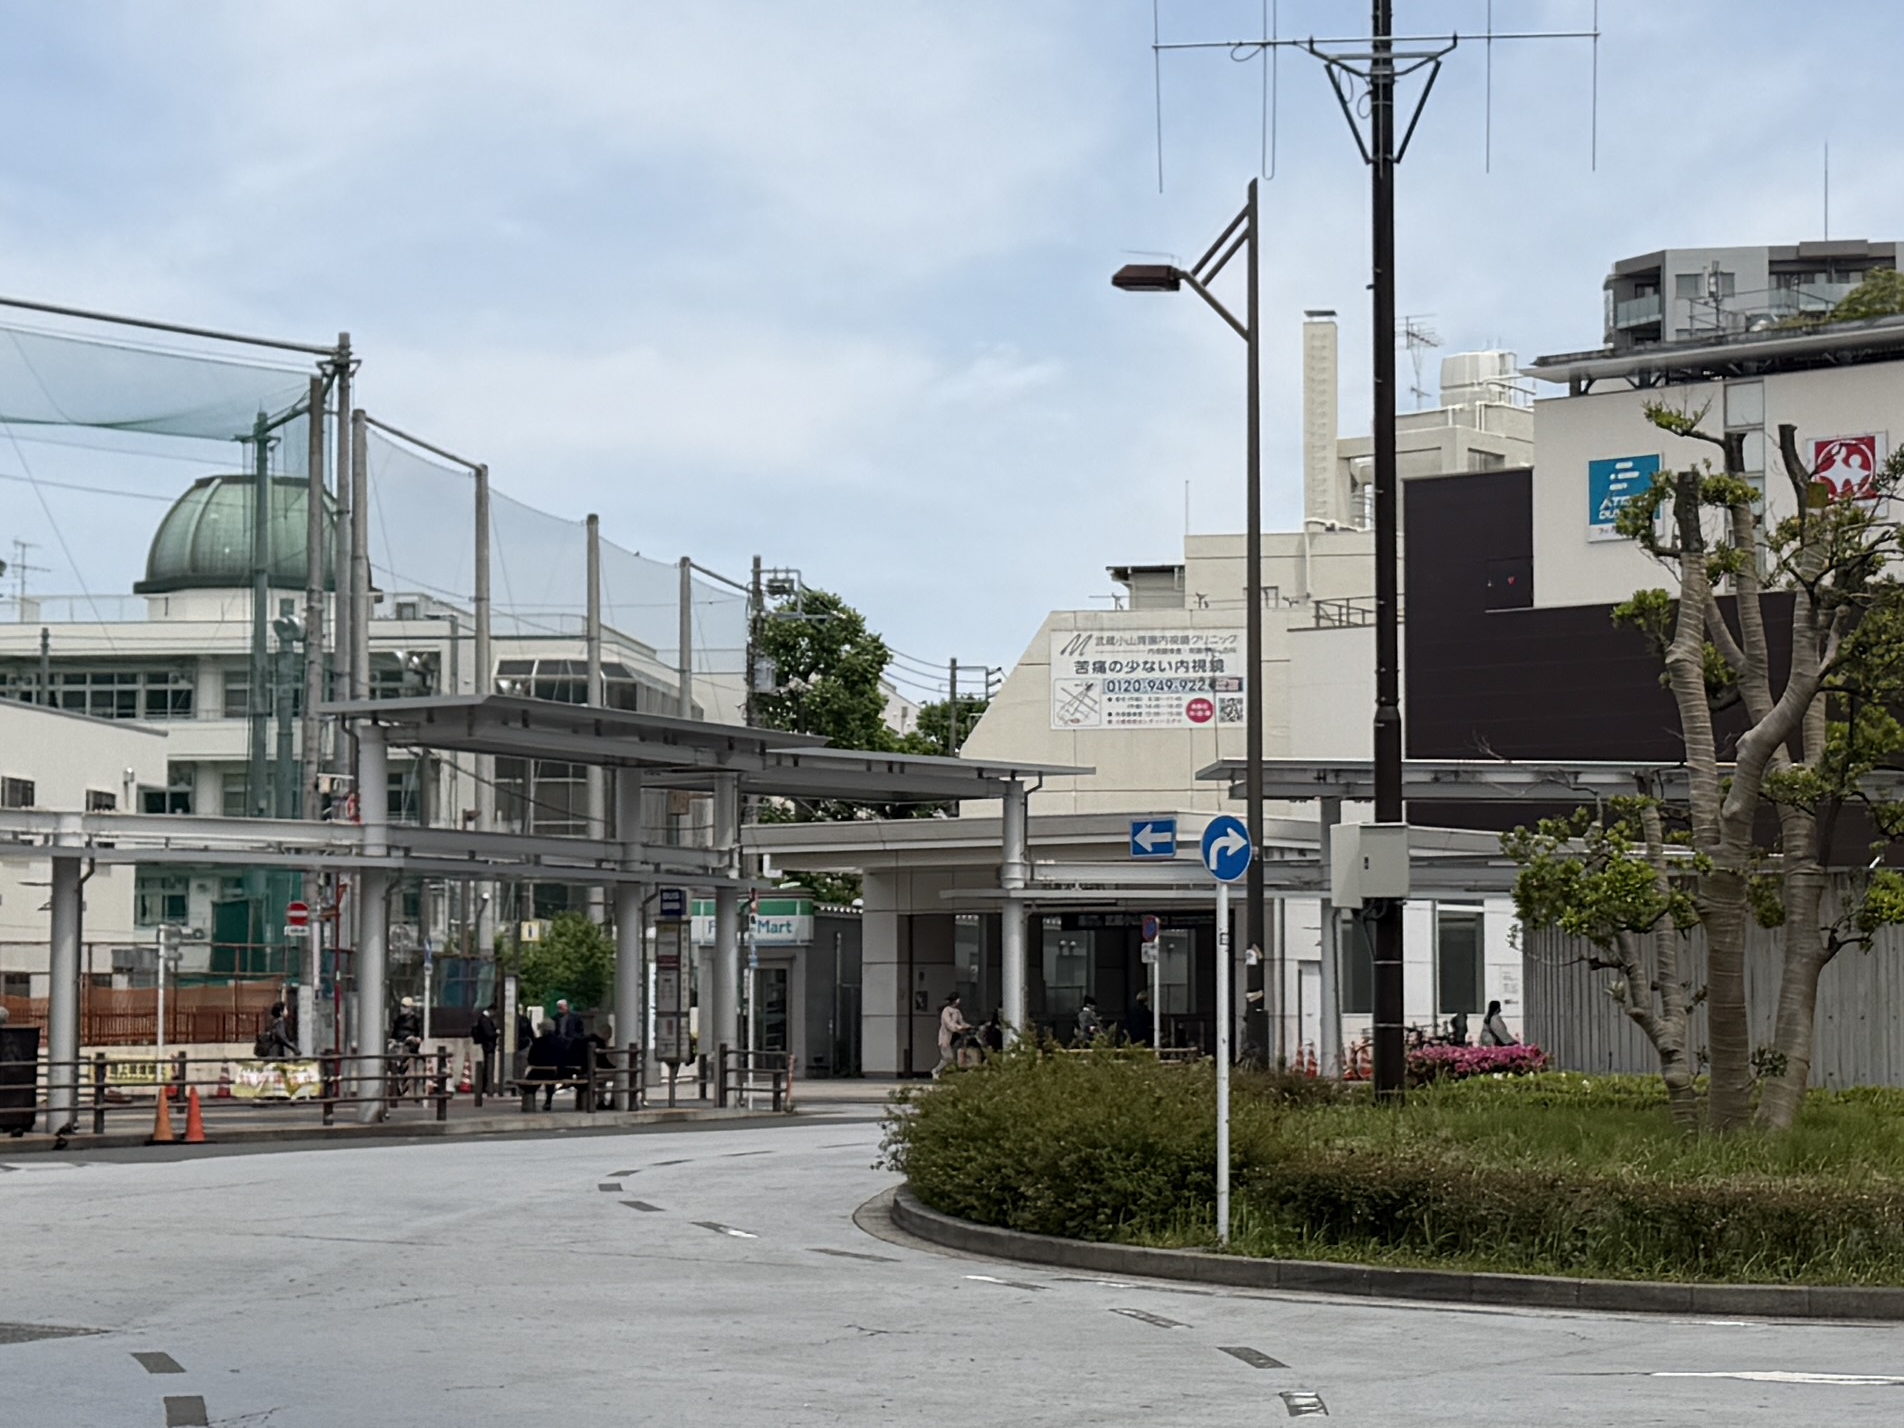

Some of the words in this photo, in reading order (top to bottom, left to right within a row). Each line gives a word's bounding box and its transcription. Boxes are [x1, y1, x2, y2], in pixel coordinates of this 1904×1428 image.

[1074, 659, 1225, 675] 苦痛の少ない内視鏡
